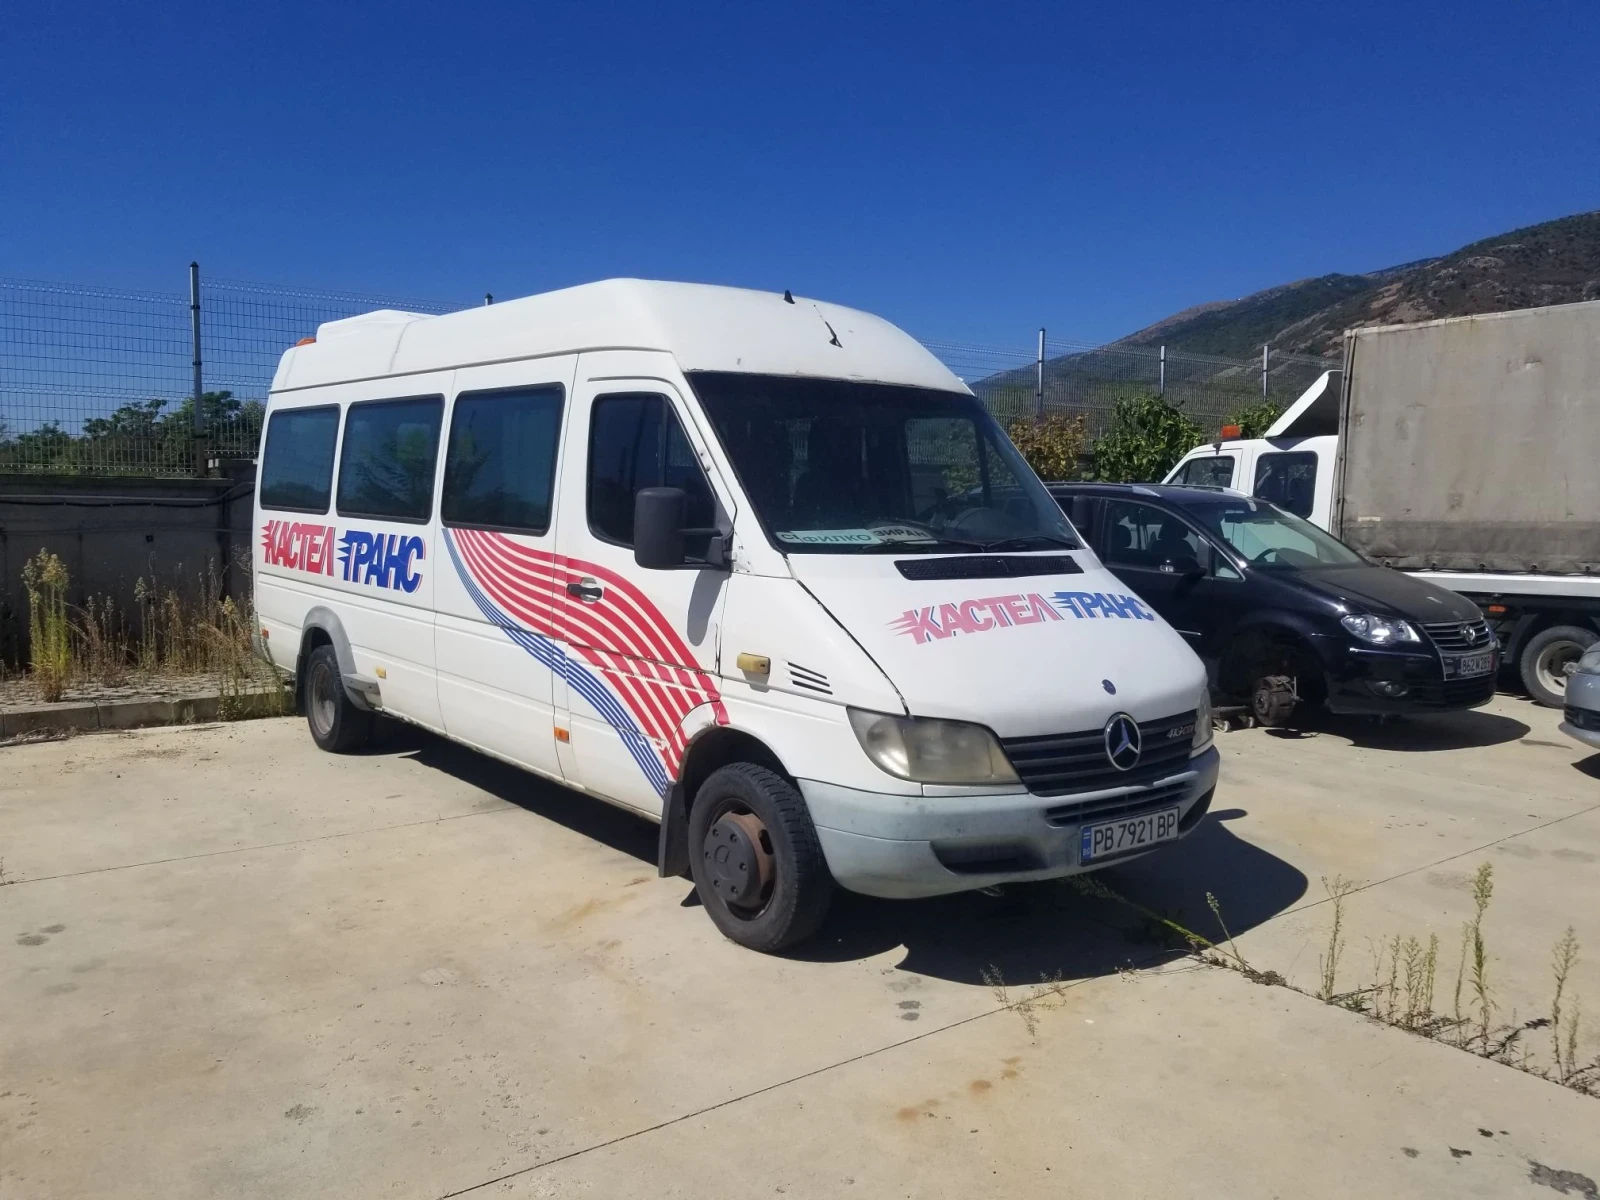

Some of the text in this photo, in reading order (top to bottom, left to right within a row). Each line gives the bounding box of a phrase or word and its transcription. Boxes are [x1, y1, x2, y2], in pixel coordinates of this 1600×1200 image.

[261, 520, 427, 593] КАСТЕЛ ТРАНС
[802, 534, 872, 543] ФИЛКО
[884, 592, 1155, 645] КАСТЕЛ ТРАНС
